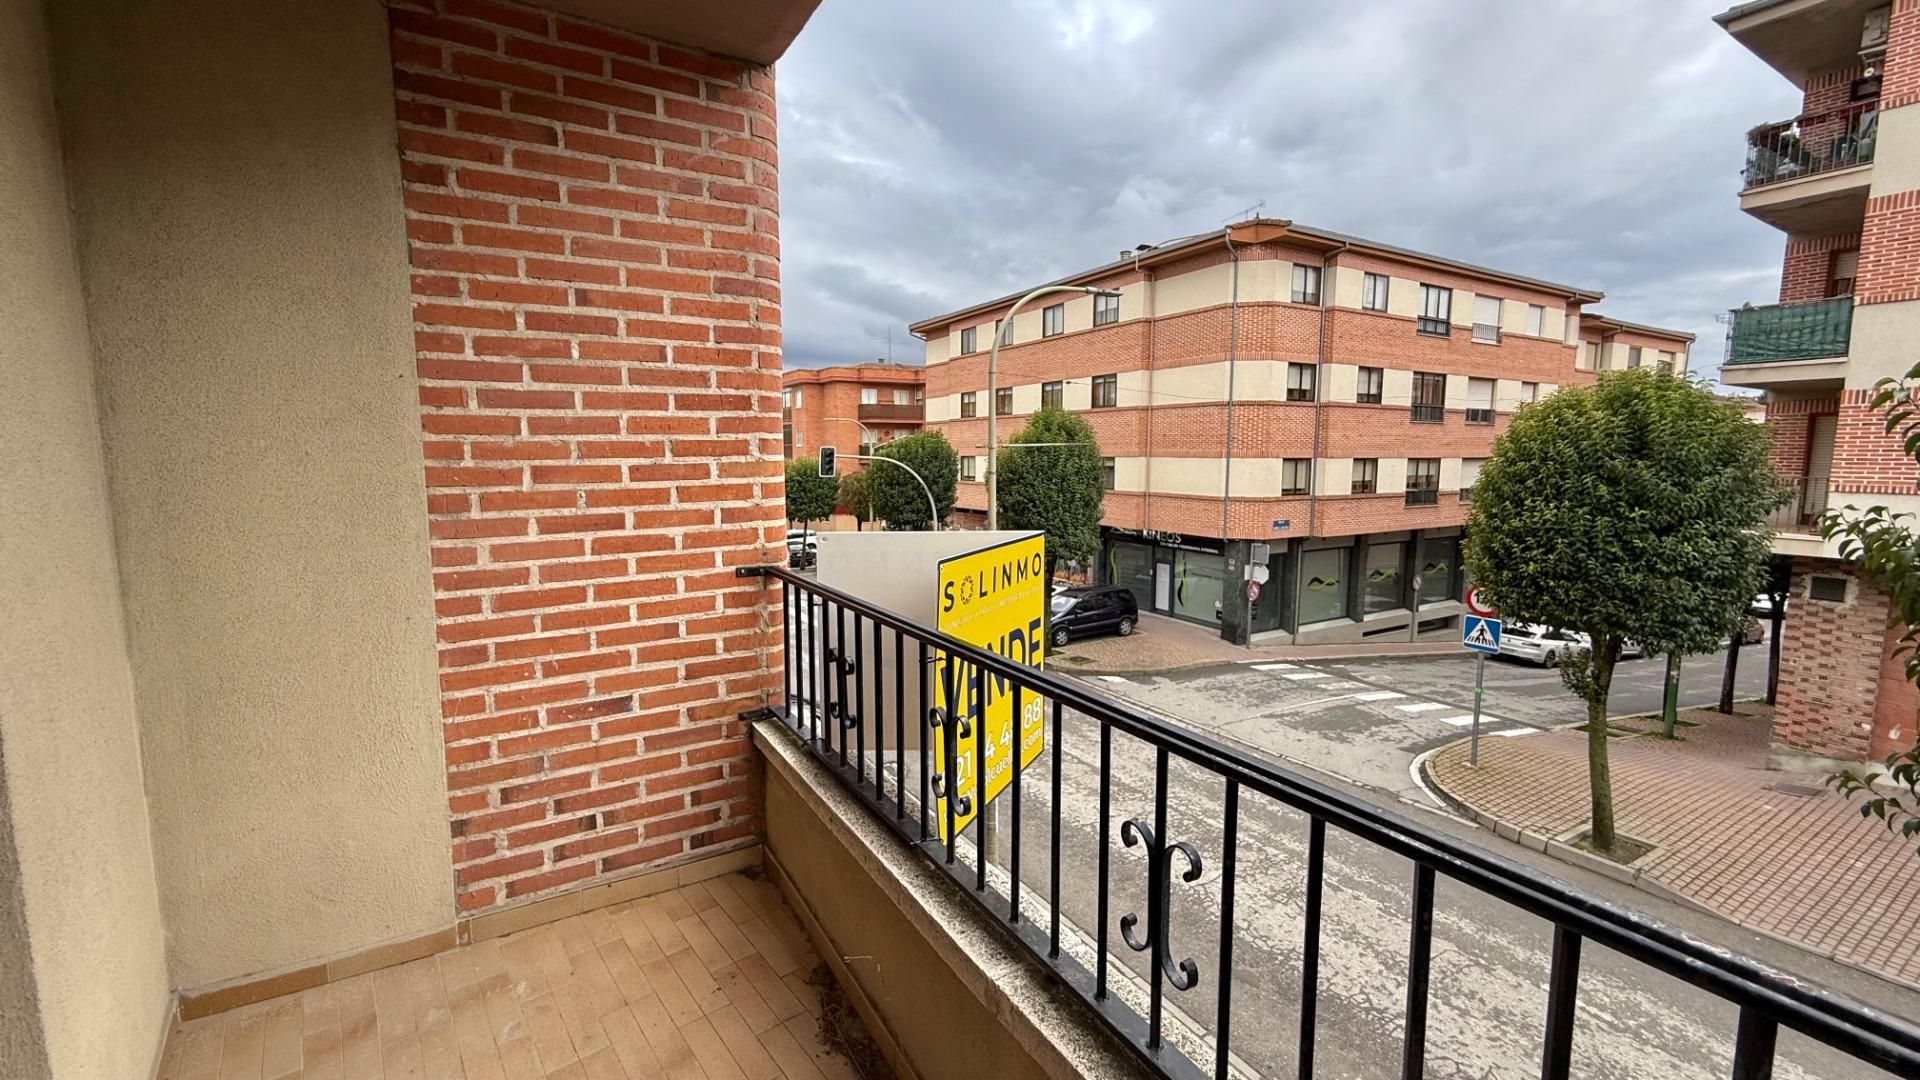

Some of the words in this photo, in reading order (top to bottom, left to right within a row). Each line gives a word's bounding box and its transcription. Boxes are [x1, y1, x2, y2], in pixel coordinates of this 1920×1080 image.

[1142, 528, 1182, 544] KINEOS
[943, 552, 1042, 613] SOLINMO
[940, 616, 1041, 724] VENDE
[1023, 697, 1041, 729] 88
